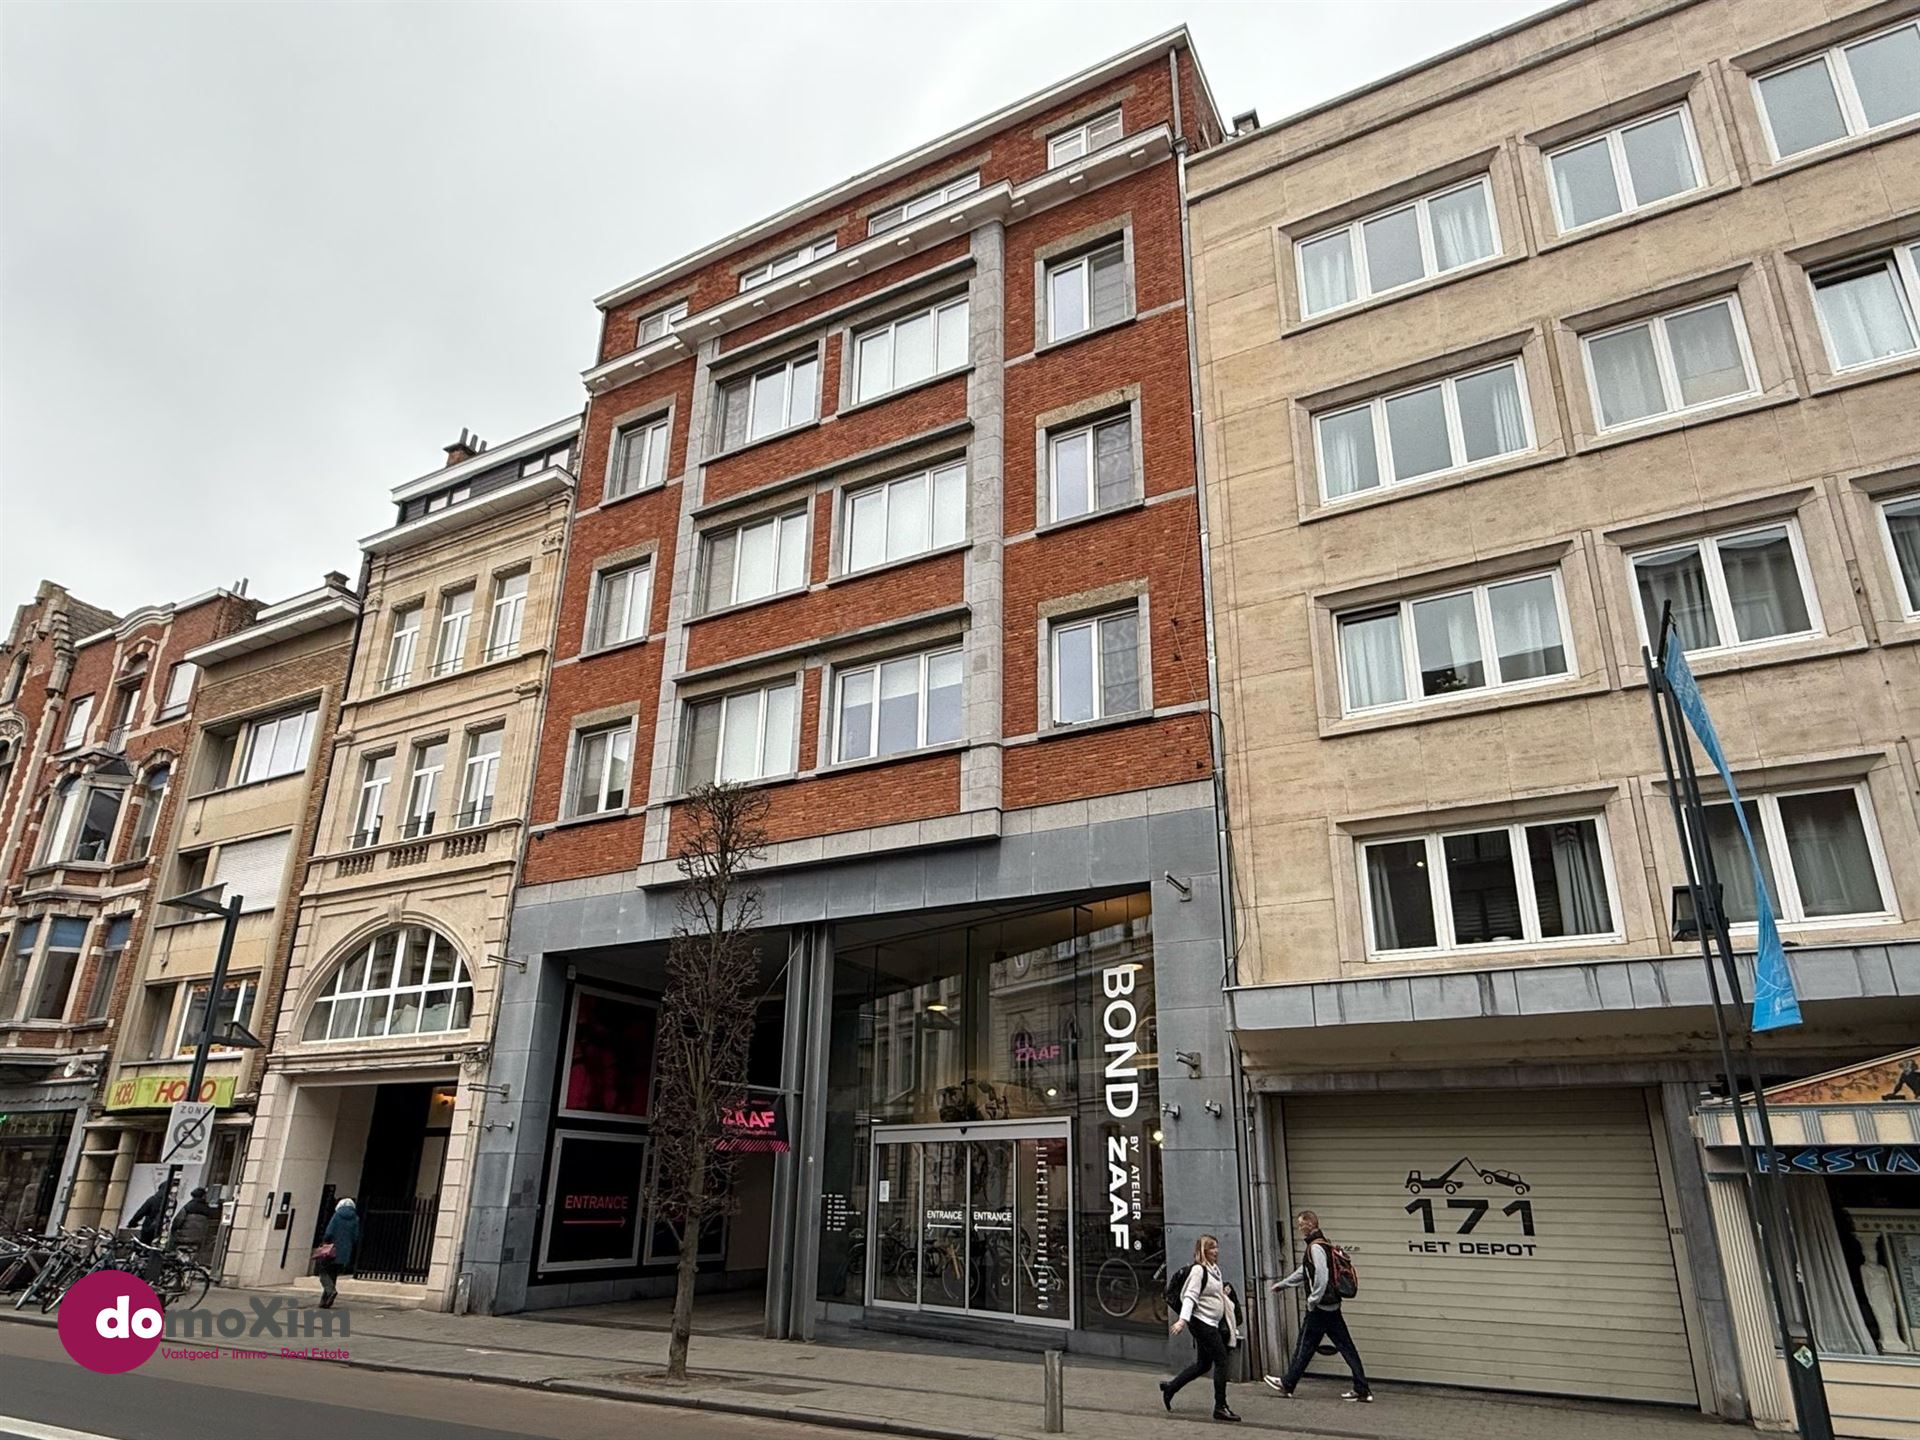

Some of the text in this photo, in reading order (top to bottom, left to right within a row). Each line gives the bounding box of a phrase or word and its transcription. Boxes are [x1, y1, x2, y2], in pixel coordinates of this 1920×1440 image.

[1103, 966, 1139, 1118] BOND
[154, 1080, 216, 1103] HOO
[180, 1105, 209, 1115] ZONE
[1130, 1135, 1142, 1220] BY ATELIER
[565, 1194, 629, 1210] ENTRANCE
[926, 1210, 963, 1220] ENTRANCE
[973, 1211, 1013, 1221] ENTRANCE
[1404, 1198, 1536, 1237] 171
[1458, 1242, 1537, 1256] DEPOT
